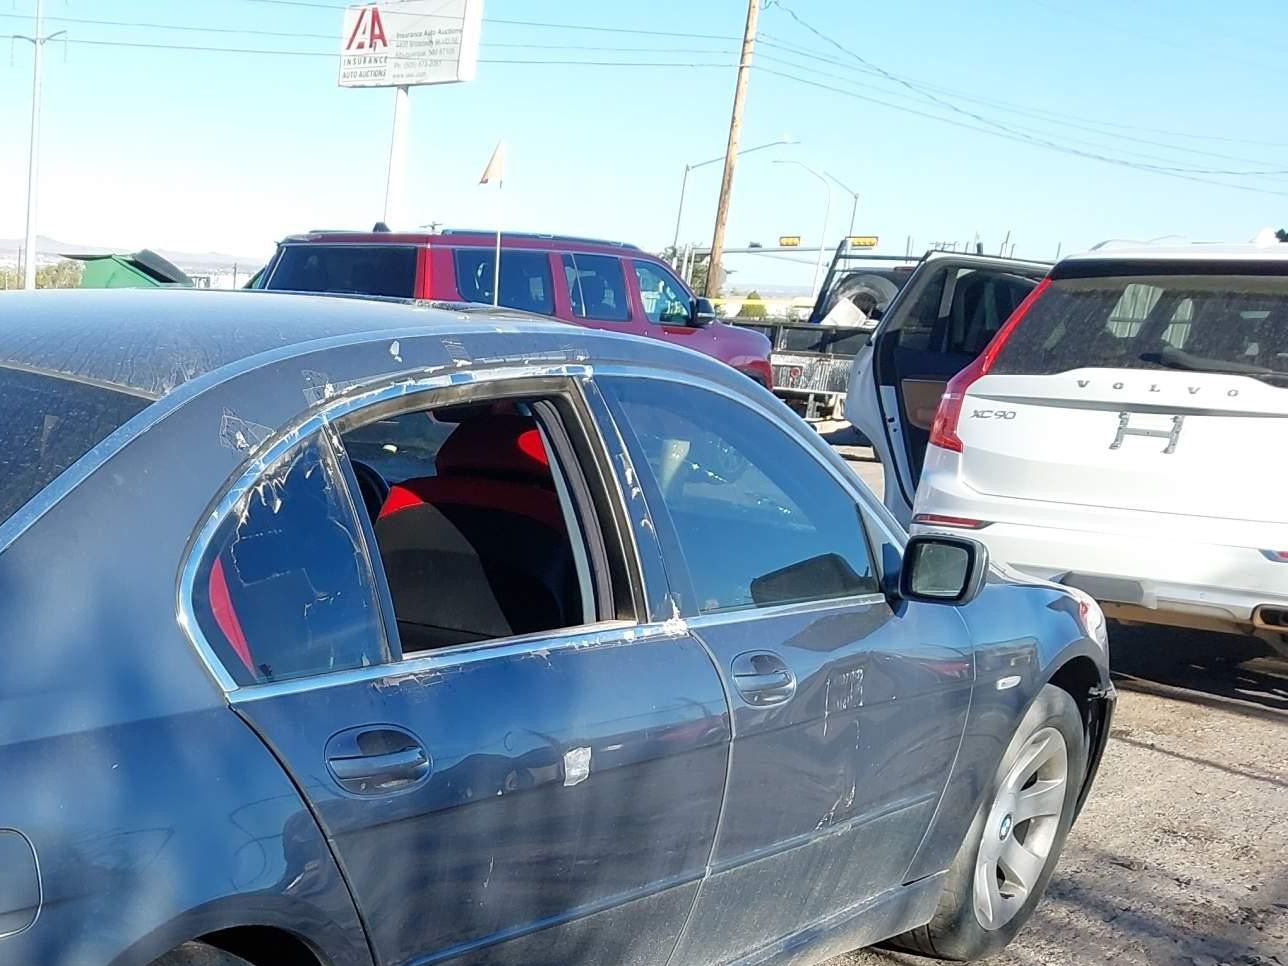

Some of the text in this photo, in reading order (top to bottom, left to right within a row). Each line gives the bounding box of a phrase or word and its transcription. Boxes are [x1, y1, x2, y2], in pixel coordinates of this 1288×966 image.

[343, 55, 388, 66] INSURANCE
[342, 70, 358, 79] AUTO
[359, 69, 387, 77] AUCTIONS
[1076, 379, 1239, 398] VOLVO
